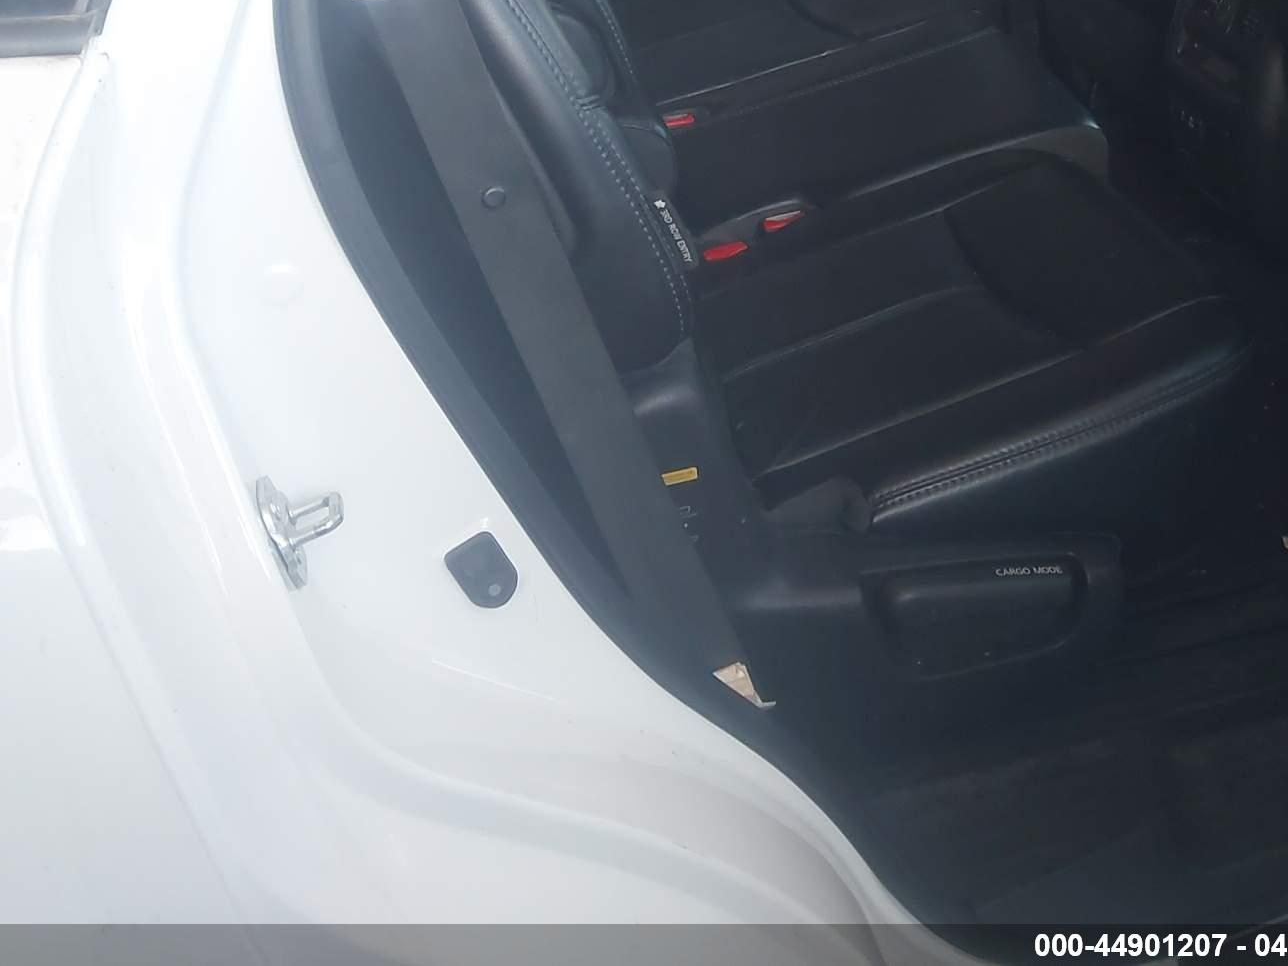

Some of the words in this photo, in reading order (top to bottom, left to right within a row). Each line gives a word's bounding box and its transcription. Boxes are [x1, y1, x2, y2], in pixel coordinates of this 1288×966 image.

[677, 240, 693, 262] ENTRY
[995, 566, 1031, 576] CARGO
[1033, 565, 1063, 574] MODE
